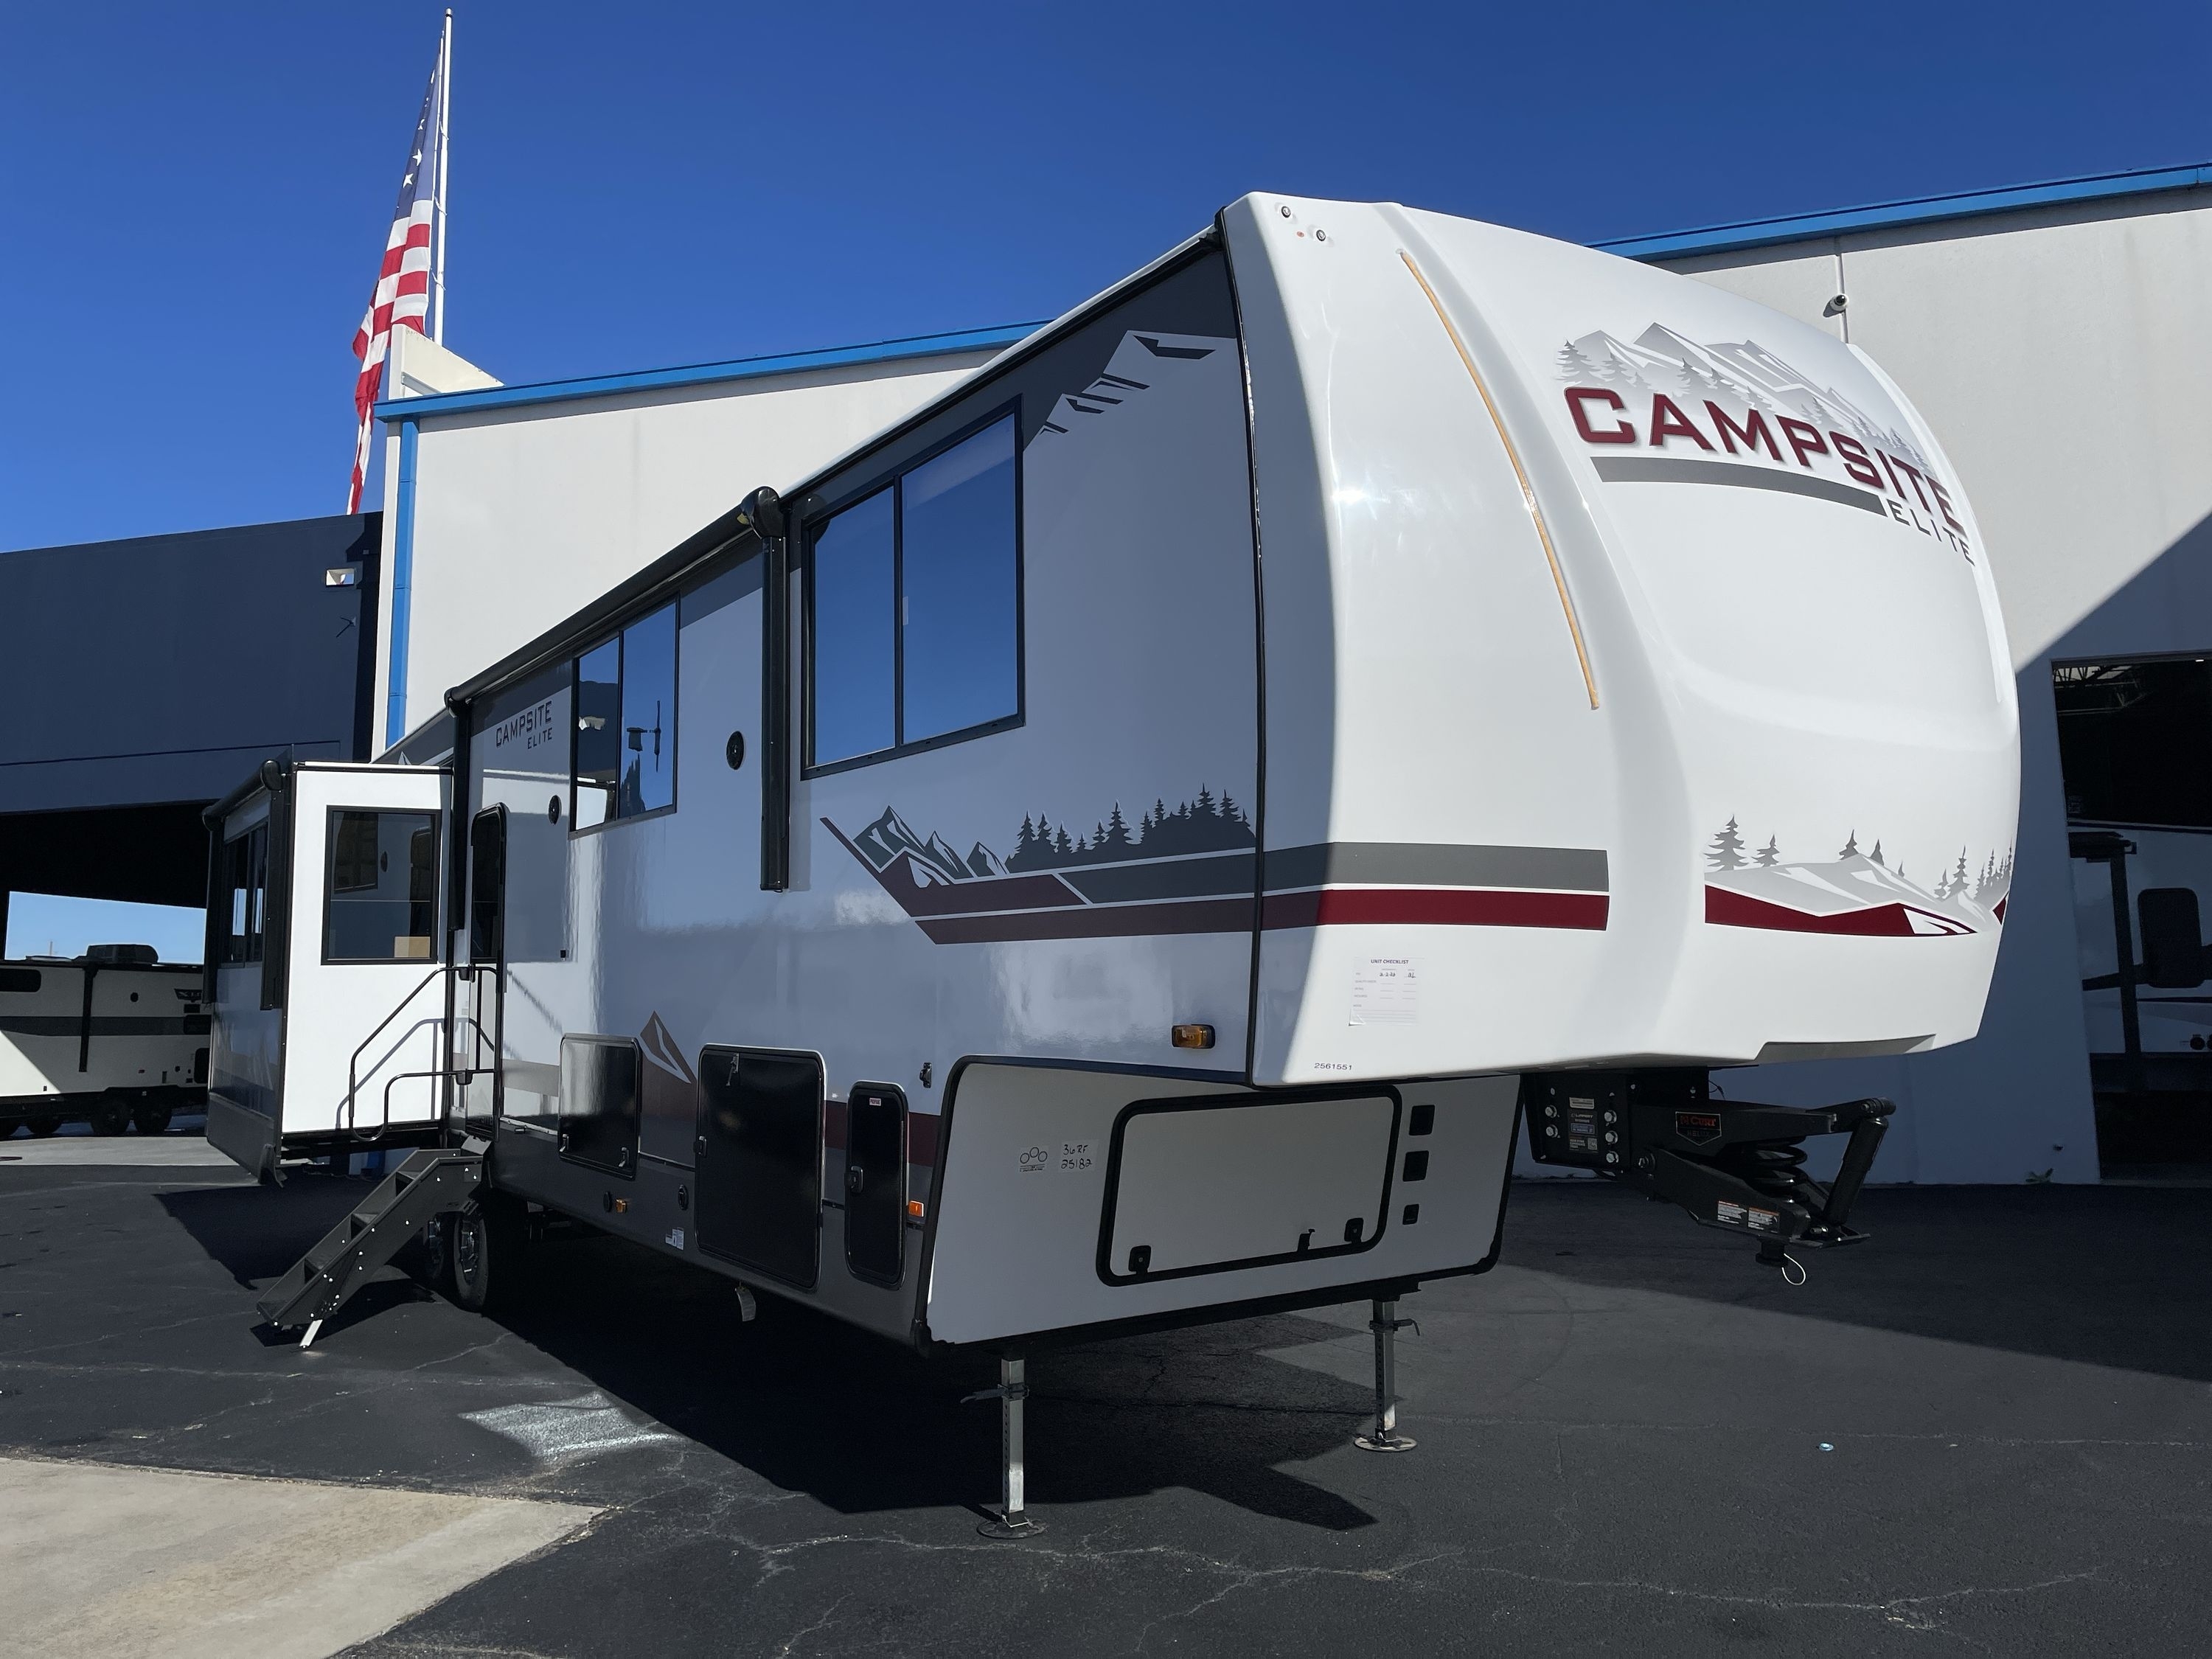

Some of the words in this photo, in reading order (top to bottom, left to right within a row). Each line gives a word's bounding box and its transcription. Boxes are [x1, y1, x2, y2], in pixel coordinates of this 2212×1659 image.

[1564, 386, 1970, 538] CAMPSITE
[1885, 498, 1975, 566] ELITE
[496, 700, 552, 748] CAMPSITE
[527, 727, 553, 750] ELITE
[1314, 1062, 1352, 1071] 2561551
[1061, 1158, 1093, 1169] 25182
